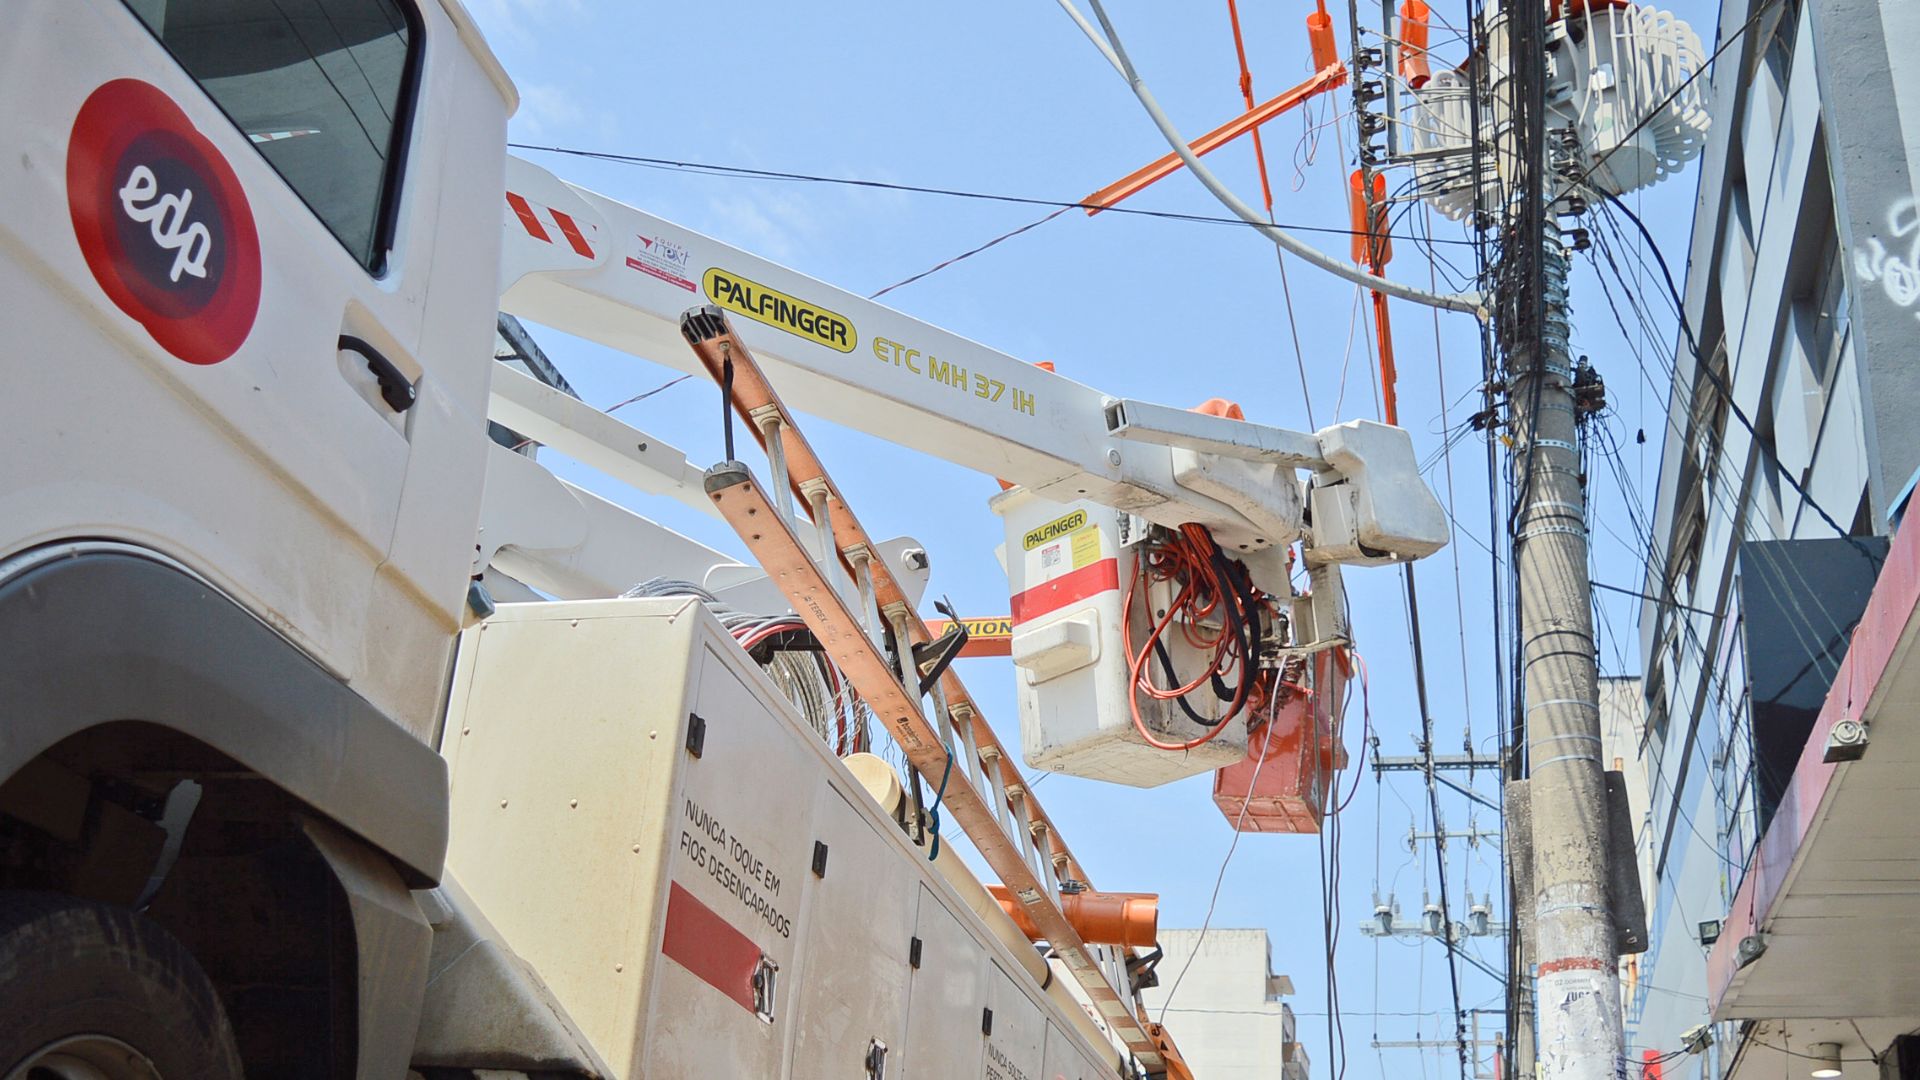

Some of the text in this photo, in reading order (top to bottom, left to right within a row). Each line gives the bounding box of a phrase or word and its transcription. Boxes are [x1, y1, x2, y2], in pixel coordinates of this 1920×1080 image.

[119, 165, 211, 282] edp
[713, 274, 847, 347] PALFINGER
[873, 336, 1036, 416] ETC MH 37 IH
[1026, 513, 1083, 548] PALFINGER
[680, 830, 791, 939] FIOS DESENCAPADOS
[685, 799, 781, 897] NUNCA TOQUE EM
[988, 1042, 1007, 1070] NUNCA
